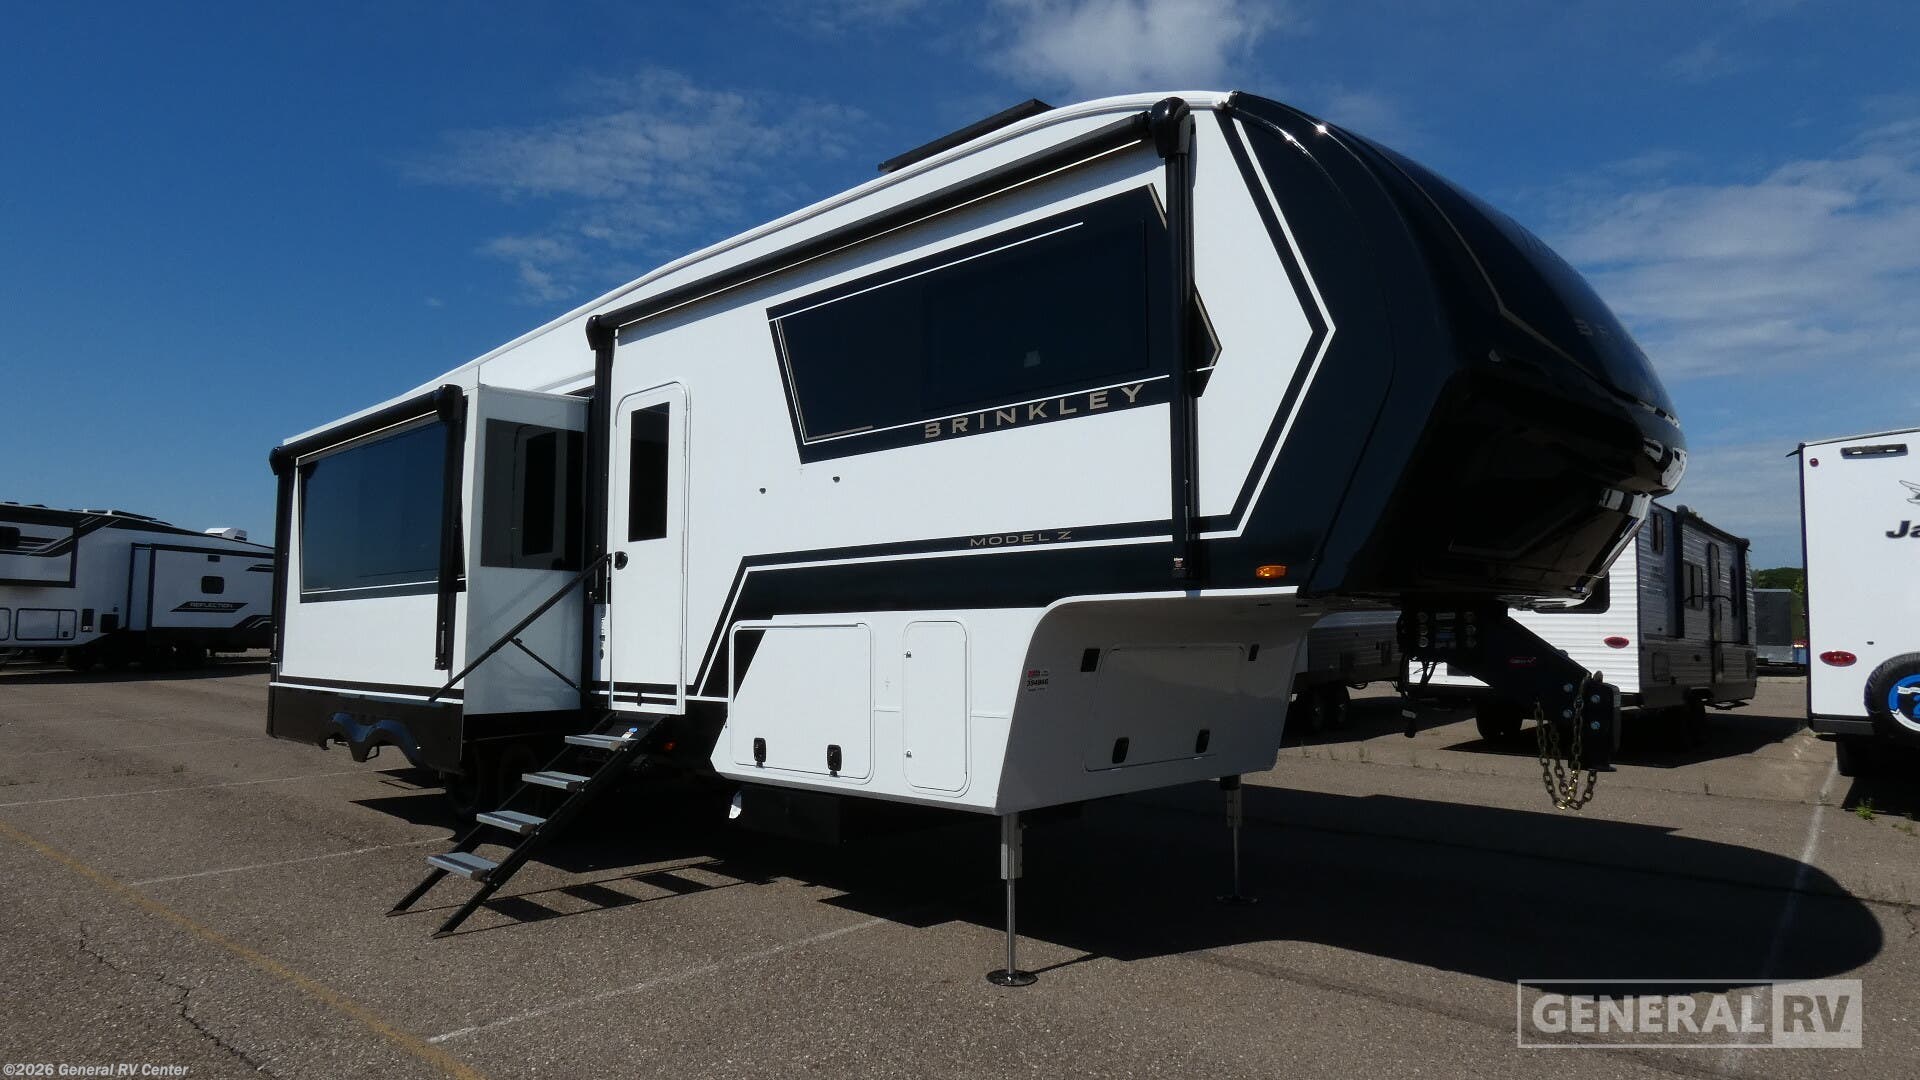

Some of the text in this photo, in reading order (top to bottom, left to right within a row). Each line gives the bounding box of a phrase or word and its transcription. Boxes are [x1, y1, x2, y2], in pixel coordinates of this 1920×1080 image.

[924, 383, 1144, 439] BRINKLEY
[970, 531, 1073, 547] MODEL Z
